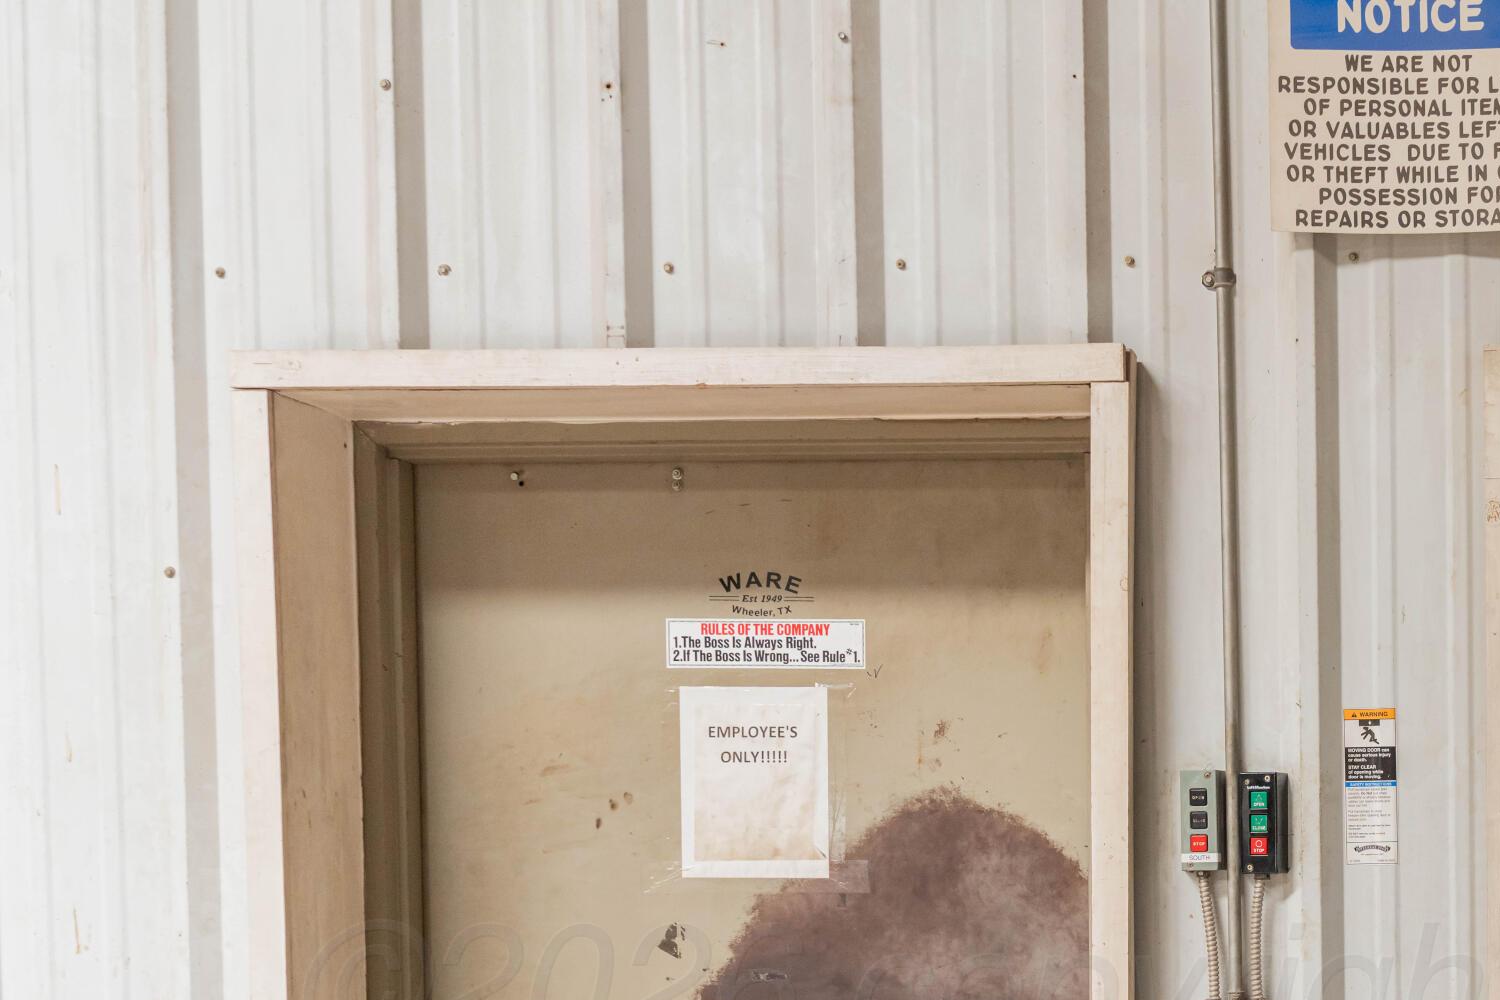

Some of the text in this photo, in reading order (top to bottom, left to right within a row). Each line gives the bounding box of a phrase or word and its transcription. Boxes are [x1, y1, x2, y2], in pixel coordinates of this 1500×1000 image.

[1337, 0, 1485, 34] NOTICE
[1345, 54, 1472, 72] WE ARE NOT
[1278, 76, 1429, 95] RESPONSIBLE
[1437, 76, 1479, 94] FOR
[1303, 98, 1330, 115] OF
[1339, 99, 1452, 117] PERSONAL
[1288, 119, 1317, 137] OR
[1326, 121, 1450, 139] VALUABLES
[1284, 142, 1391, 161] VEHICLES
[1407, 143, 1450, 162] DUE
[1458, 142, 1484, 160] TO
[1286, 165, 1315, 182] OR
[1323, 166, 1388, 183] THEFT
[1396, 166, 1459, 183] WHILE
[1468, 165, 1487, 182] IN
[1319, 187, 1457, 206] POSSESSION
[1295, 209, 1389, 228] REPAIRS
[1398, 210, 1426, 228] OR
[719, 571, 802, 594] WARE
[742, 595, 783, 603] Est 1949
[732, 605, 792, 617] Wheeler, TX
[701, 623, 830, 636] RULES OF THE COMPANY
[704, 637, 730, 649] Boss
[732, 637, 742, 649] Is
[744, 637, 783, 650] Always
[786, 637, 817, 650] Right.
[693, 651, 713, 662] The
[715, 651, 741, 662] Boss
[743, 651, 752, 662] Is
[755, 651, 798, 664] Wrong...
[801, 651, 820, 662] See
[708, 726, 798, 738] EMPLOYEE'S
[721, 751, 787, 763] ONLY!!!!!
